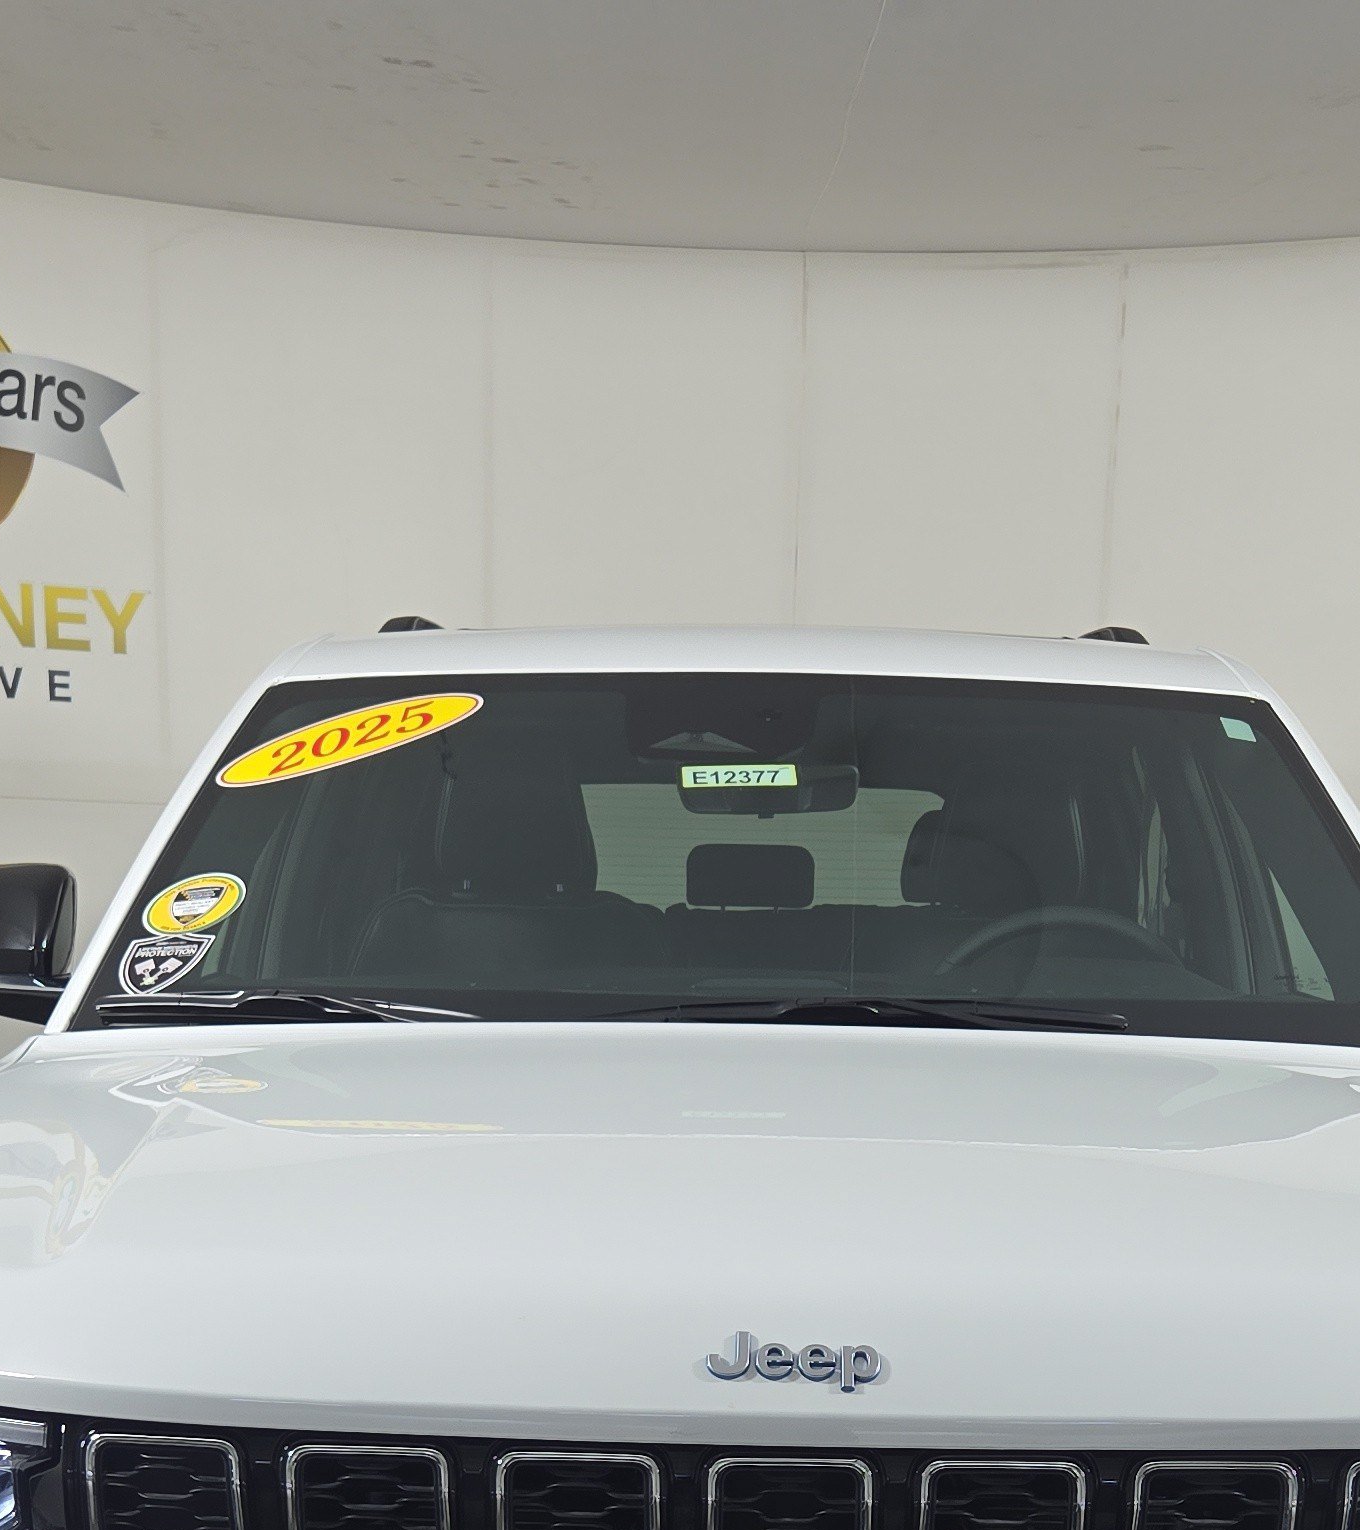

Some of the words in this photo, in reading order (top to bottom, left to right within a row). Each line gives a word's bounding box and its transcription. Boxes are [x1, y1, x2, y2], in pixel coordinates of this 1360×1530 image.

[269, 701, 434, 776] 2025
[693, 770, 780, 784] E12377
[706, 1331, 881, 1393] Jeep
